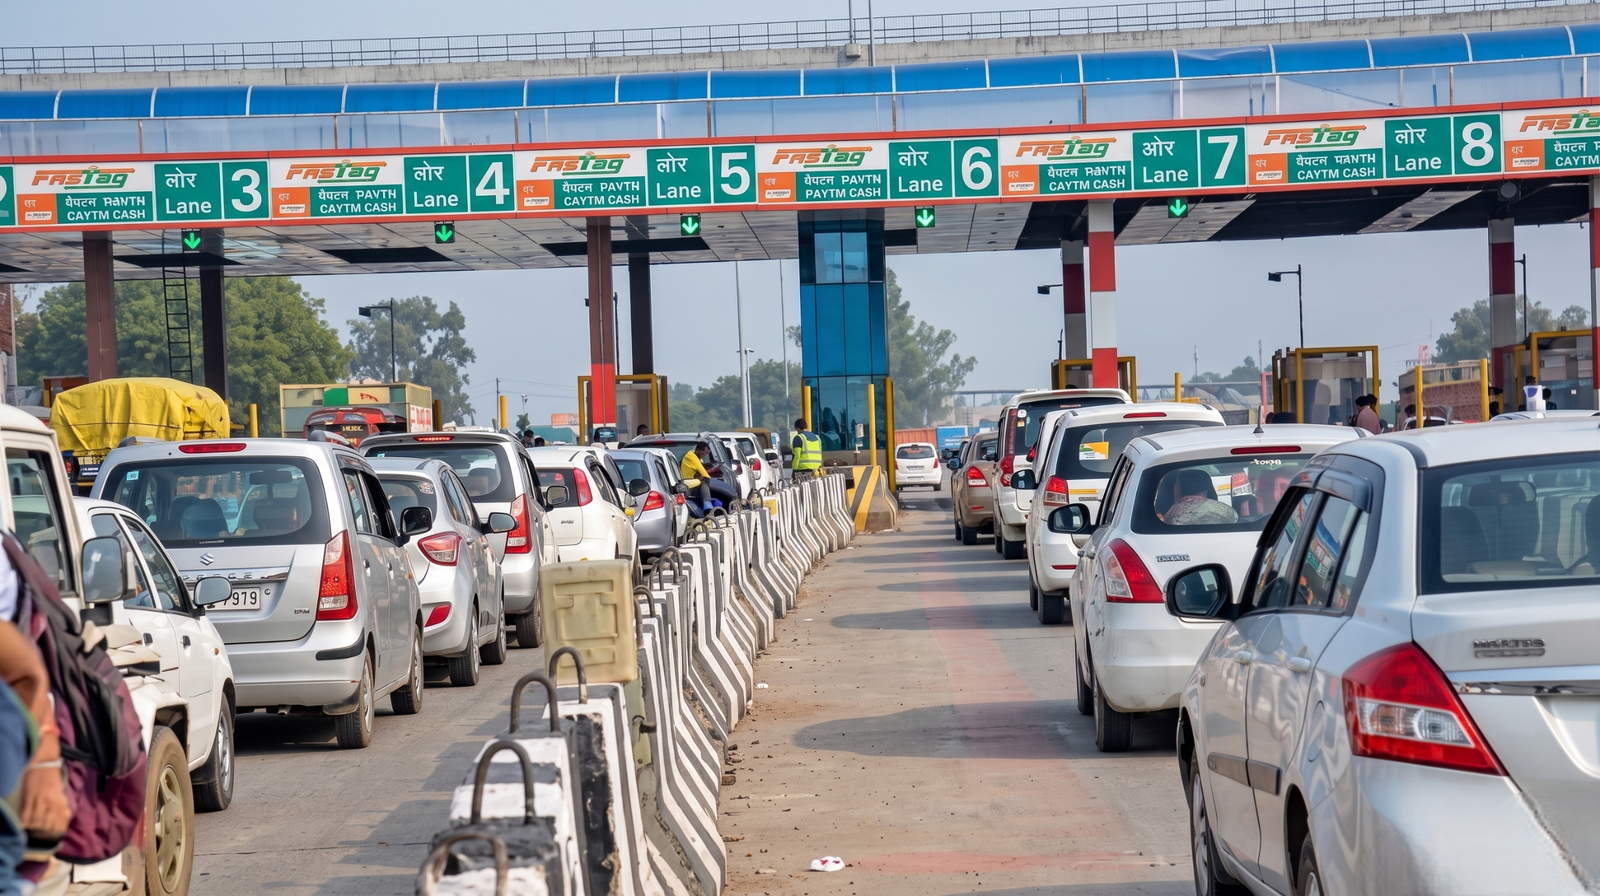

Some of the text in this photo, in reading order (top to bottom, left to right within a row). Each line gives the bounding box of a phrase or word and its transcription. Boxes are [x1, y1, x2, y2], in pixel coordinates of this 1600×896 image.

[1263, 125, 1360, 149] FASTag
[1461, 121, 1494, 167] 8
[772, 146, 866, 168] FASTag
[1015, 137, 1110, 160] FASTag
[1207, 135, 1238, 180] 7
[530, 153, 625, 176] FASTag
[961, 146, 993, 190] 6
[1394, 154, 1442, 172] Lane
[1555, 154, 1600, 167] CAYTM
[31, 167, 130, 190] FASTag
[285, 161, 381, 184] FASTag
[720, 152, 751, 195] 5
[1143, 167, 1189, 184] Lane
[1297, 167, 1376, 180] CAYTM CASH
[231, 168, 262, 212] 3
[475, 161, 510, 205] 4
[656, 182, 702, 199] Lane
[898, 176, 943, 193] Lane
[1049, 179, 1125, 191] CAYTM CASH
[413, 192, 459, 208] Lane
[564, 194, 640, 206] CAYTM CASH
[805, 187, 881, 199] PAYTM CASH
[67, 209, 146, 221] CAYTM CASH
[165, 198, 212, 215] Lane
[320, 202, 397, 214] CAYTM CASH
